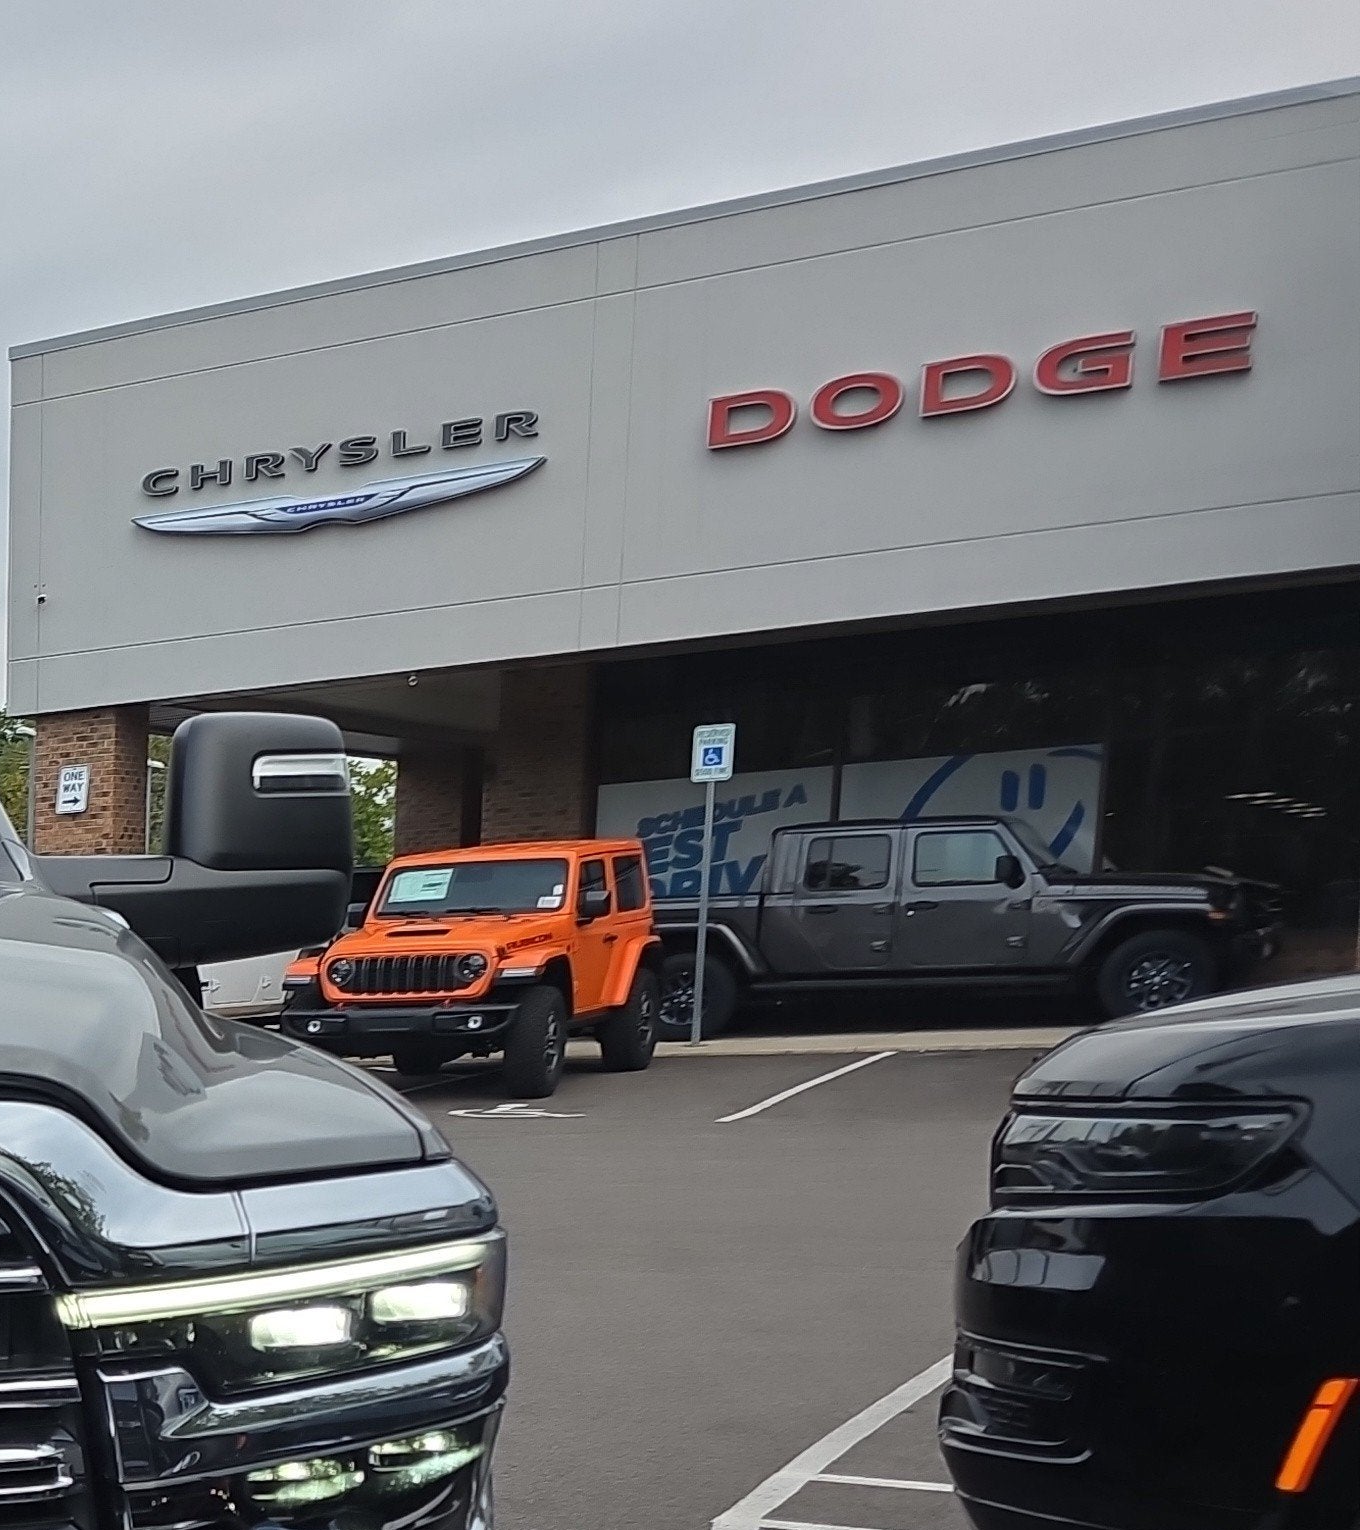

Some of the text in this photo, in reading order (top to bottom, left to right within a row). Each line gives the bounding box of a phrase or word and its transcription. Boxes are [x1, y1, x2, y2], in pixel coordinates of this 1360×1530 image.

[706, 309, 1258, 451] DODGE
[141, 408, 540, 498] CHRYSLER
[62, 782, 85, 793] WAY
[63, 770, 85, 781] ONE
[782, 783, 808, 809] A
[643, 820, 743, 876] EST
[649, 853, 769, 898] RIV
